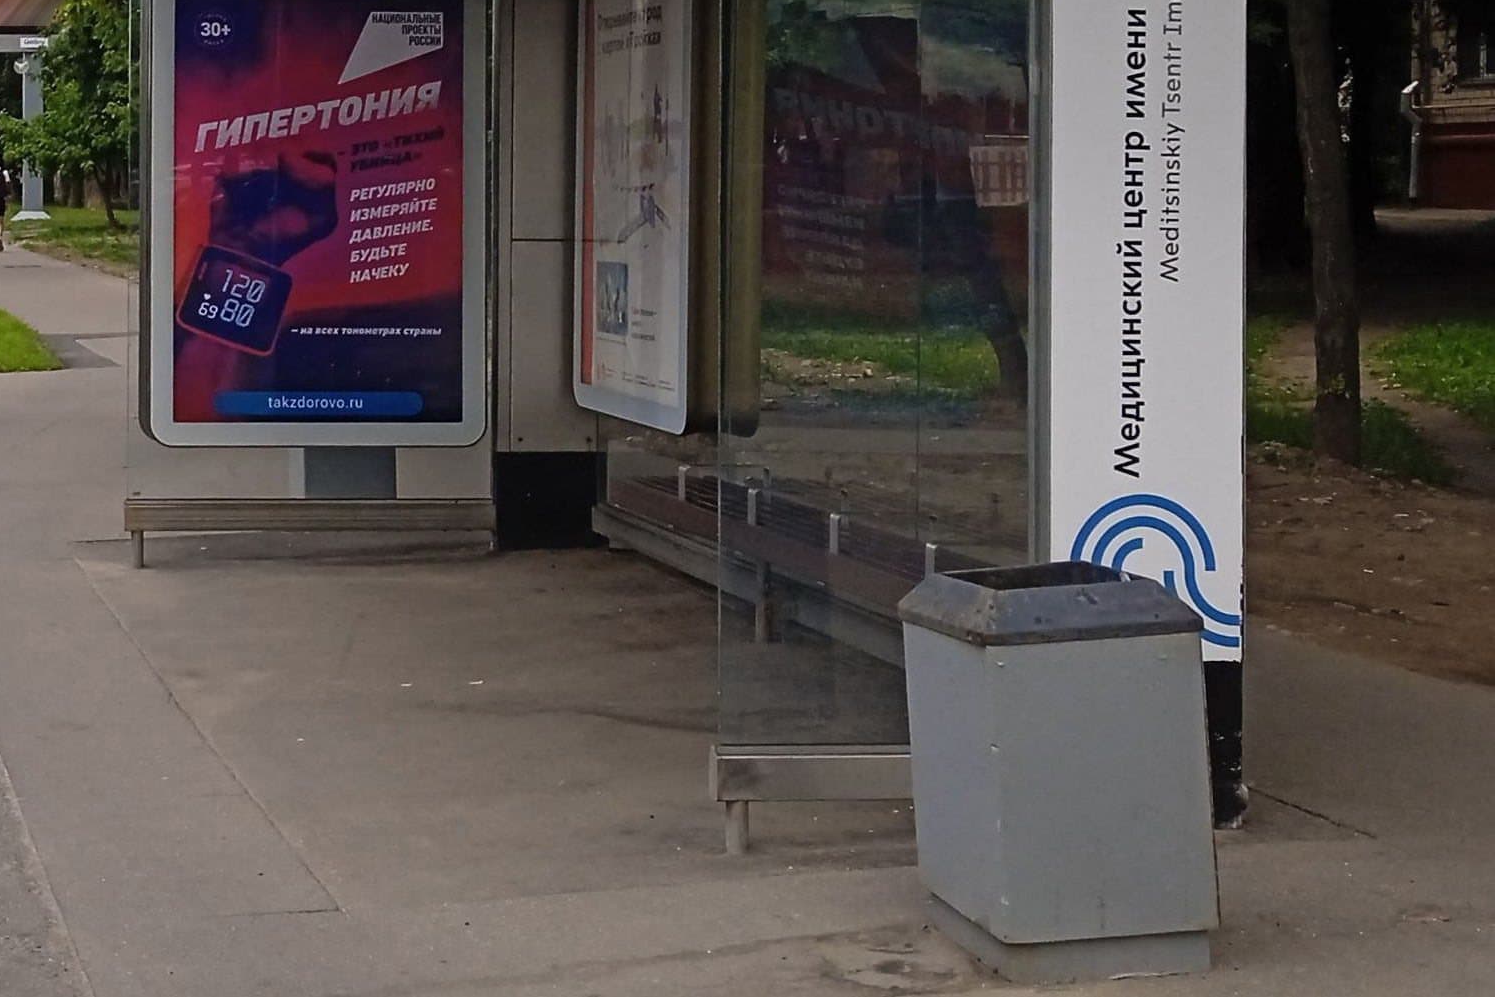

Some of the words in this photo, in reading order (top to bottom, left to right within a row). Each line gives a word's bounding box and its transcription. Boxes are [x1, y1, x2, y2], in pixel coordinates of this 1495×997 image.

[200, 21, 231, 37] 30+
[371, 12, 442, 25] НАЦИОНАЛЬНЫЕ
[401, 24, 442, 36] ПРОЕКТЫ
[408, 35, 442, 47] РОССИИ
[1125, 8, 1147, 118] имени
[1161, 41, 1183, 118] Tsentr
[194, 80, 442, 153] ГИПЕРТОНИЯ
[349, 178, 436, 202] РЕГУЛЯРНО
[1123, 130, 1151, 228] центр
[349, 197, 438, 222] ИЗМЕРЯЙТЕ
[1159, 122, 1186, 283] Meditsinskiy
[348, 219, 434, 245] ДАВЛЕНИЕ.
[349, 243, 408, 264] БУДЬТЕ
[349, 262, 410, 284] НАЧЕКУ
[221, 269, 266, 304] 120
[198, 301, 219, 320] 69
[219, 298, 255, 328] 80
[300, 327, 313, 335] на
[315, 326, 339, 335] всех
[341, 326, 401, 337] тонометрах
[403, 326, 442, 337] страны
[1113, 241, 1146, 478] Медицинский
[267, 396, 364, 410] takzdorovo.ru
